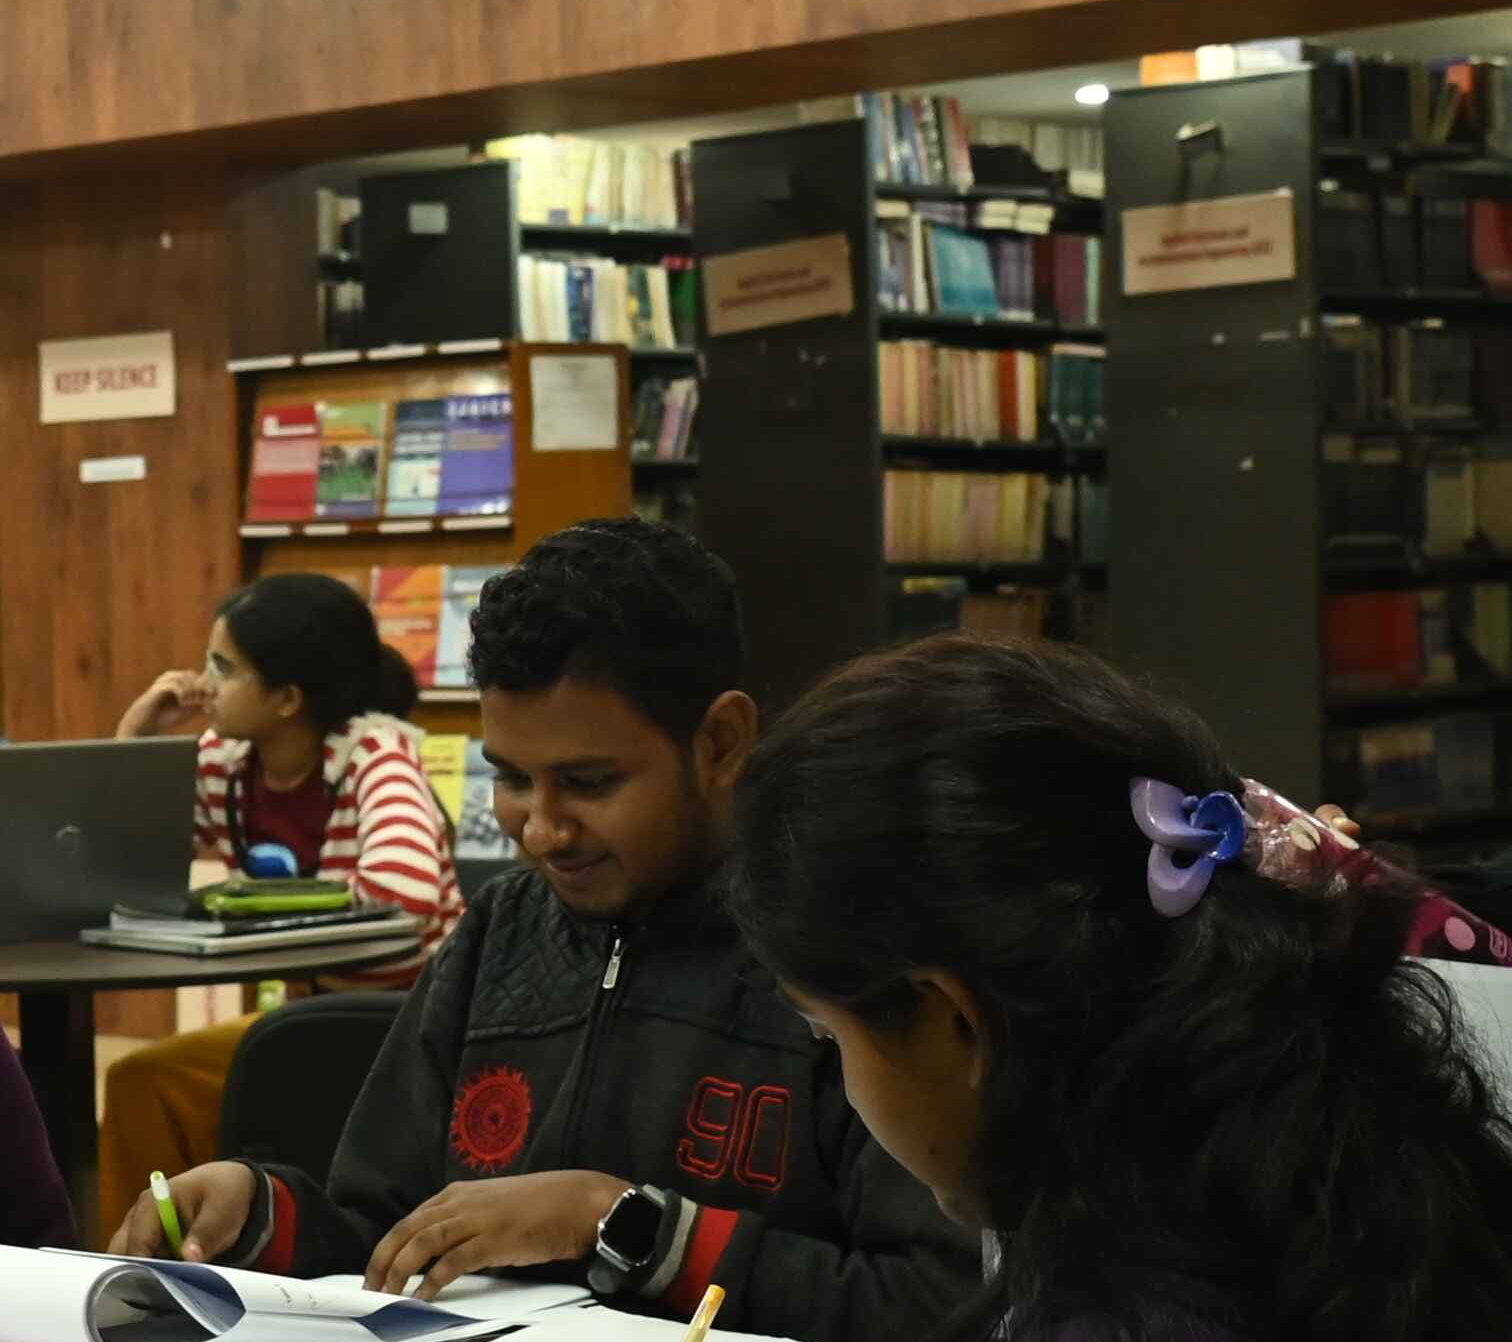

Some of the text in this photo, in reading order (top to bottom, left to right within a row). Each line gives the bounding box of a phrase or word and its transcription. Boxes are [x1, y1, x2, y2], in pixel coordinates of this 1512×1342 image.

[55, 364, 159, 395] KEEP SILENCE
[676, 1075, 794, 1192] 90
